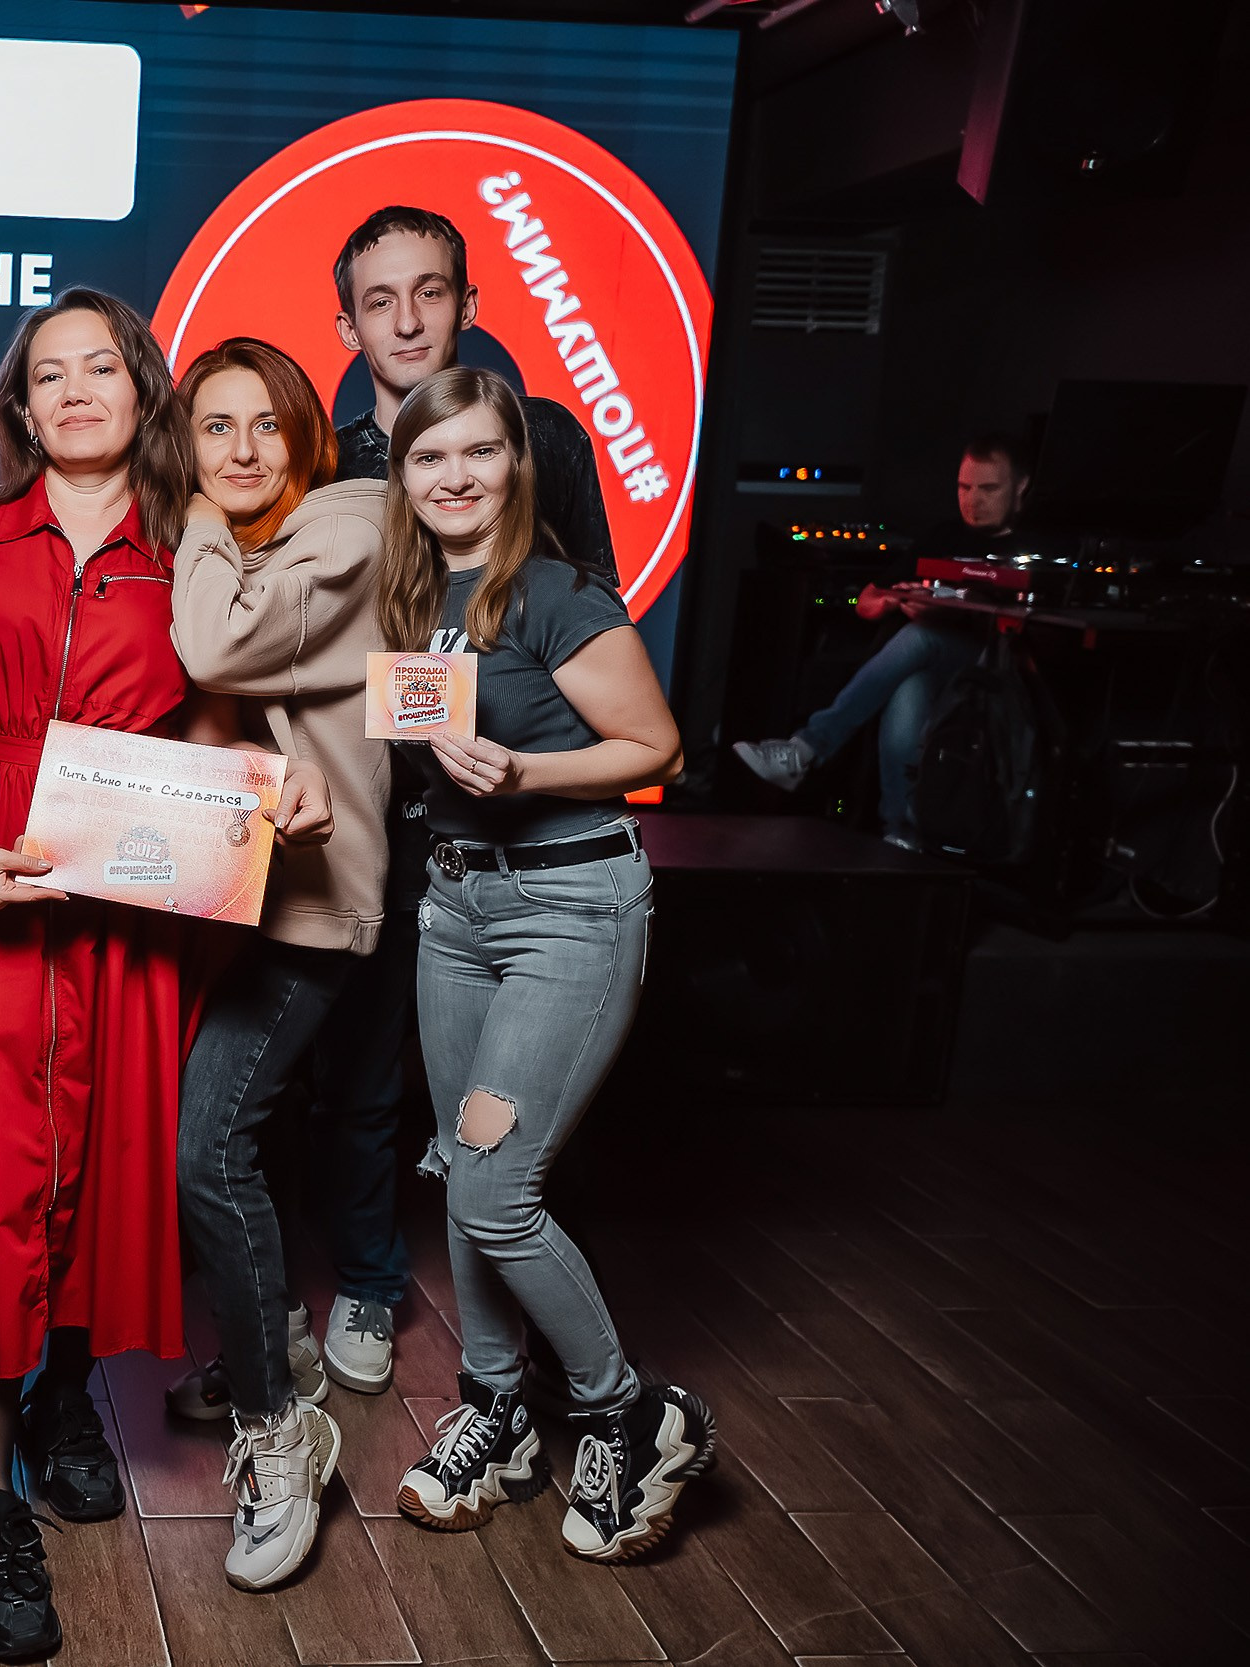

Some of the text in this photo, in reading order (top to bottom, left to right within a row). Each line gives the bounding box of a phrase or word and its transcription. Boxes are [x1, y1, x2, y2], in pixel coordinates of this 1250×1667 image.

[478, 170, 670, 503] #ПОШУМИМ?
[405, 693, 435, 705] QUIZ
[59, 765, 87, 782] Пить
[92, 771, 122, 787] Вино
[161, 784, 242, 806] Сдаваться
[124, 841, 162, 860] QUIZ
